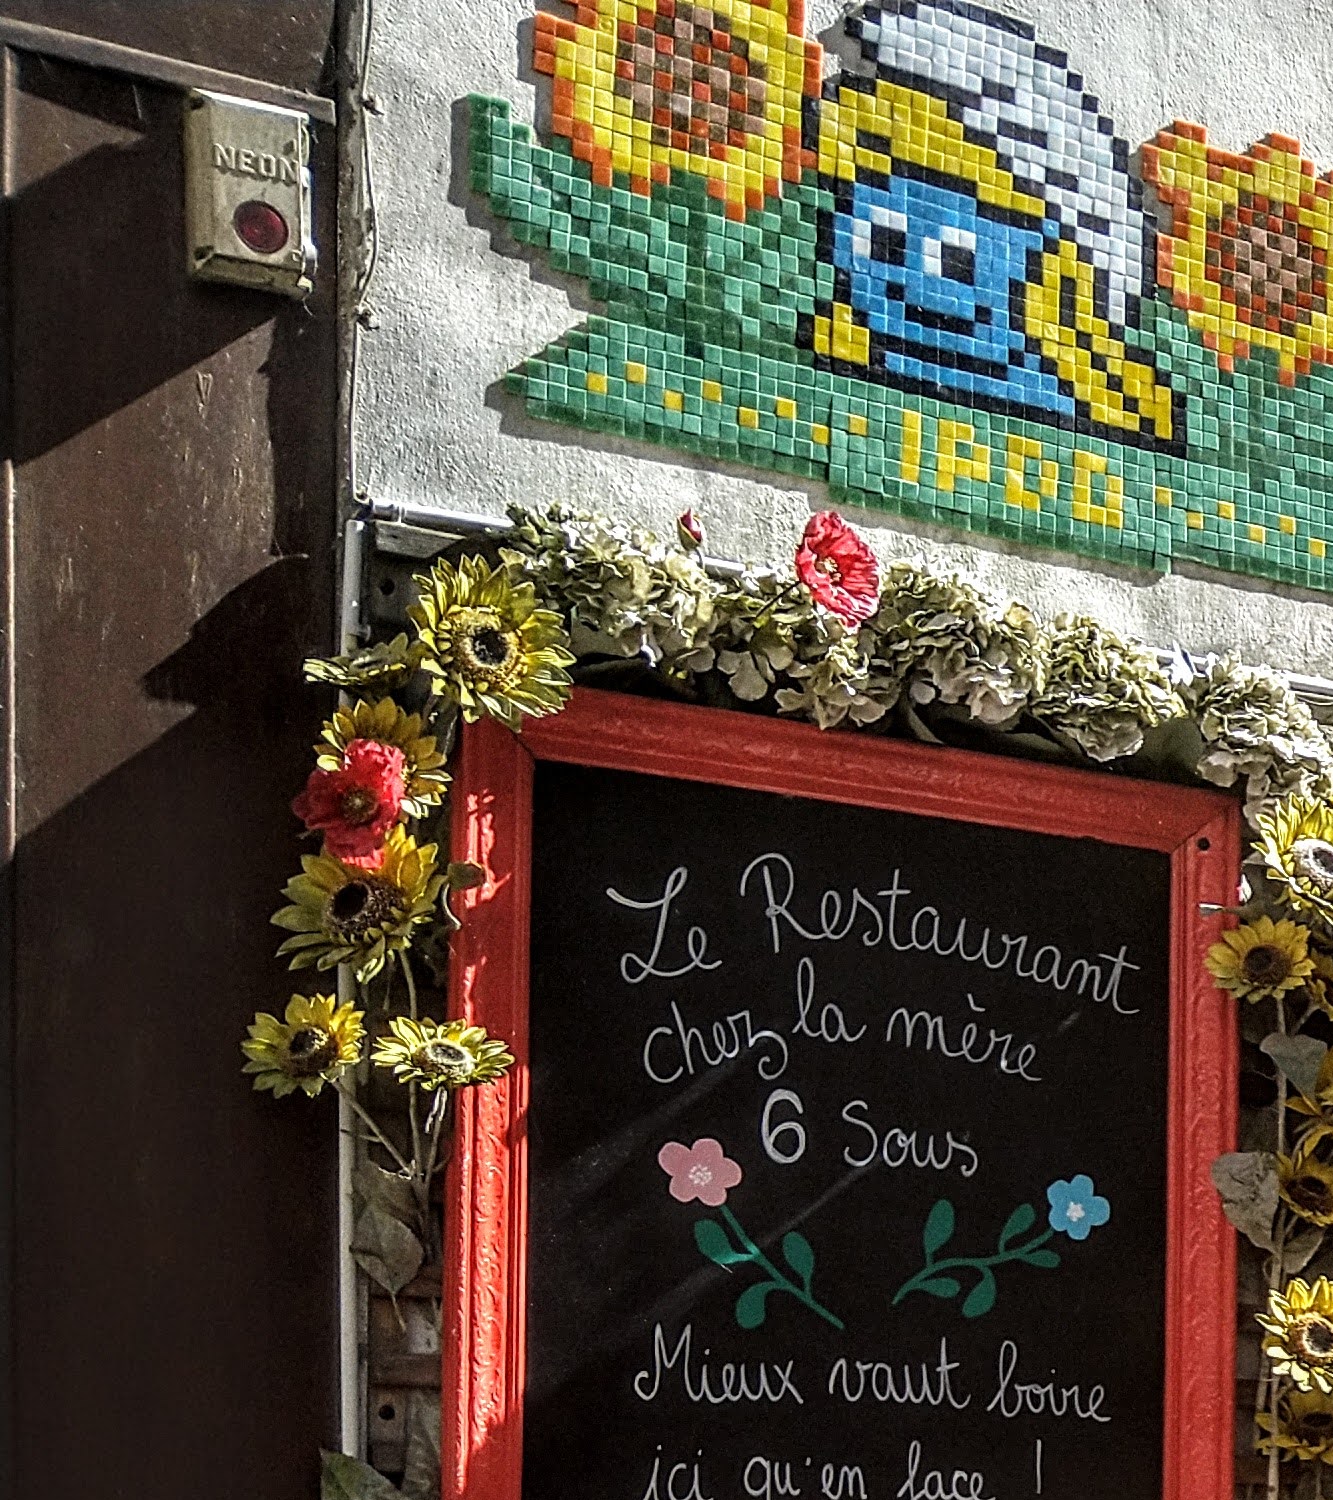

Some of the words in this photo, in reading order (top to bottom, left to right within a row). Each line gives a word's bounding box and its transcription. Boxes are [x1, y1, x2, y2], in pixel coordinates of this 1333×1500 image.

[213, 142, 299, 182] NEON
[607, 866, 723, 984] Le
[740, 852, 1140, 1015] Restaurant
[793, 956, 867, 1044] la
[886, 993, 1042, 1082] mère
[760, 1088, 807, 1165] 6
[634, 1322, 803, 1405] Mieux
[828, 1337, 971, 1410] vaut
[986, 1340, 1111, 1422] boire
